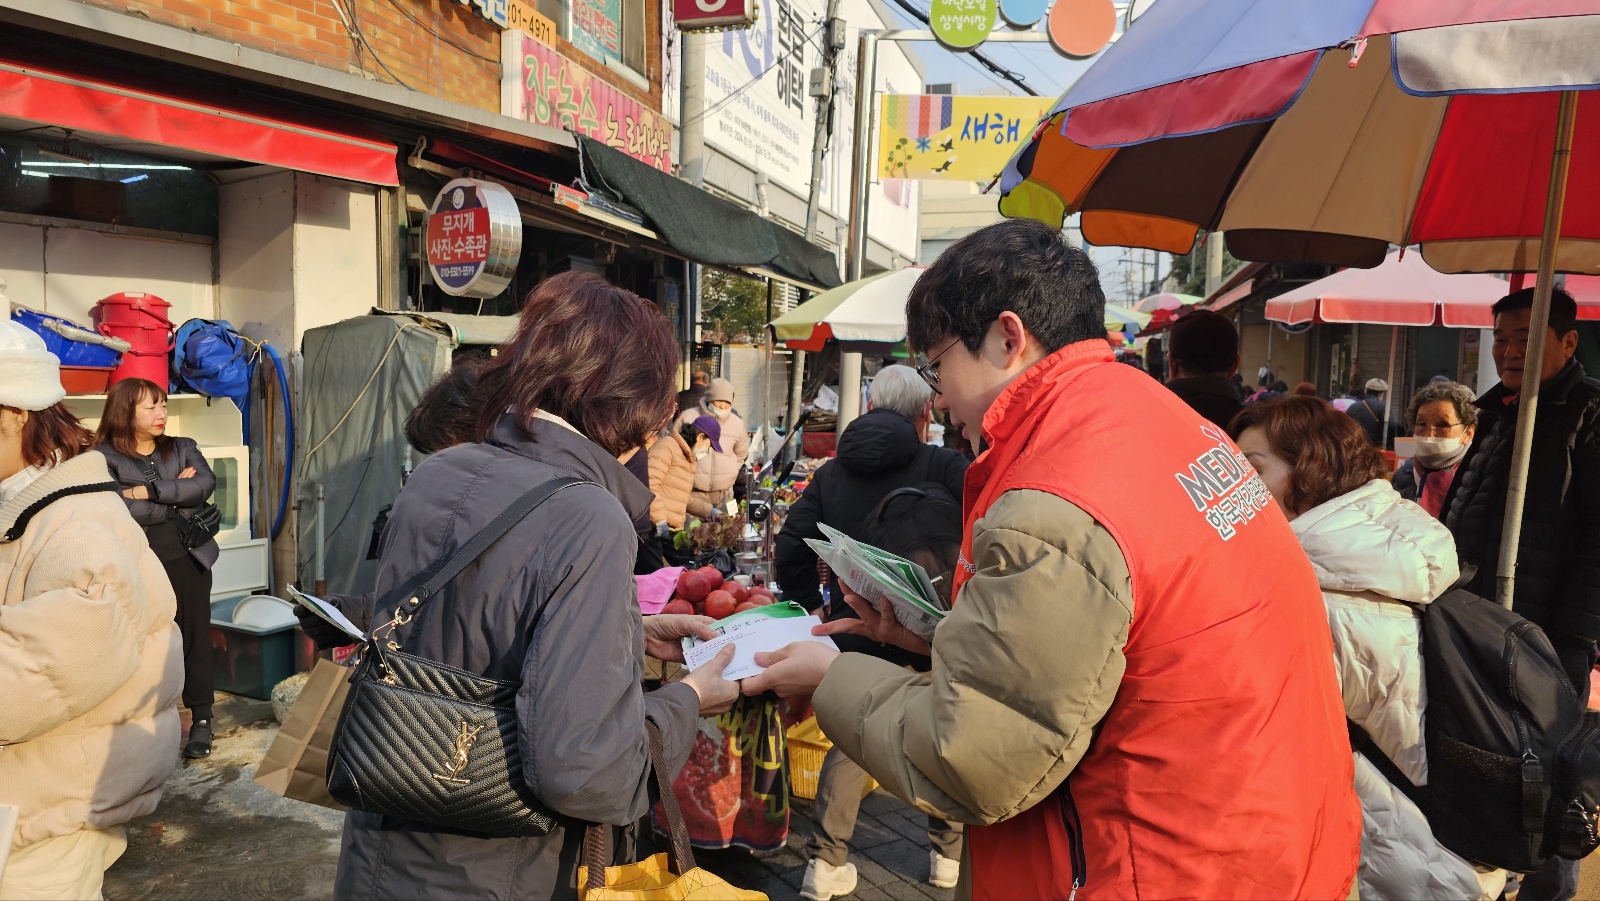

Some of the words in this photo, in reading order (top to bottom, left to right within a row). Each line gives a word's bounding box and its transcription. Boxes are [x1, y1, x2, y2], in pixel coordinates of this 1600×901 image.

[508, 3, 550, 45] 01-4971
[939, 14, 988, 31] 상설시장
[777, 51, 804, 121] 혜택
[524, 54, 599, 138] 장녹수
[606, 103, 669, 172] 노래방
[960, 112, 1021, 145] 새해
[442, 211, 475, 236] 무지개
